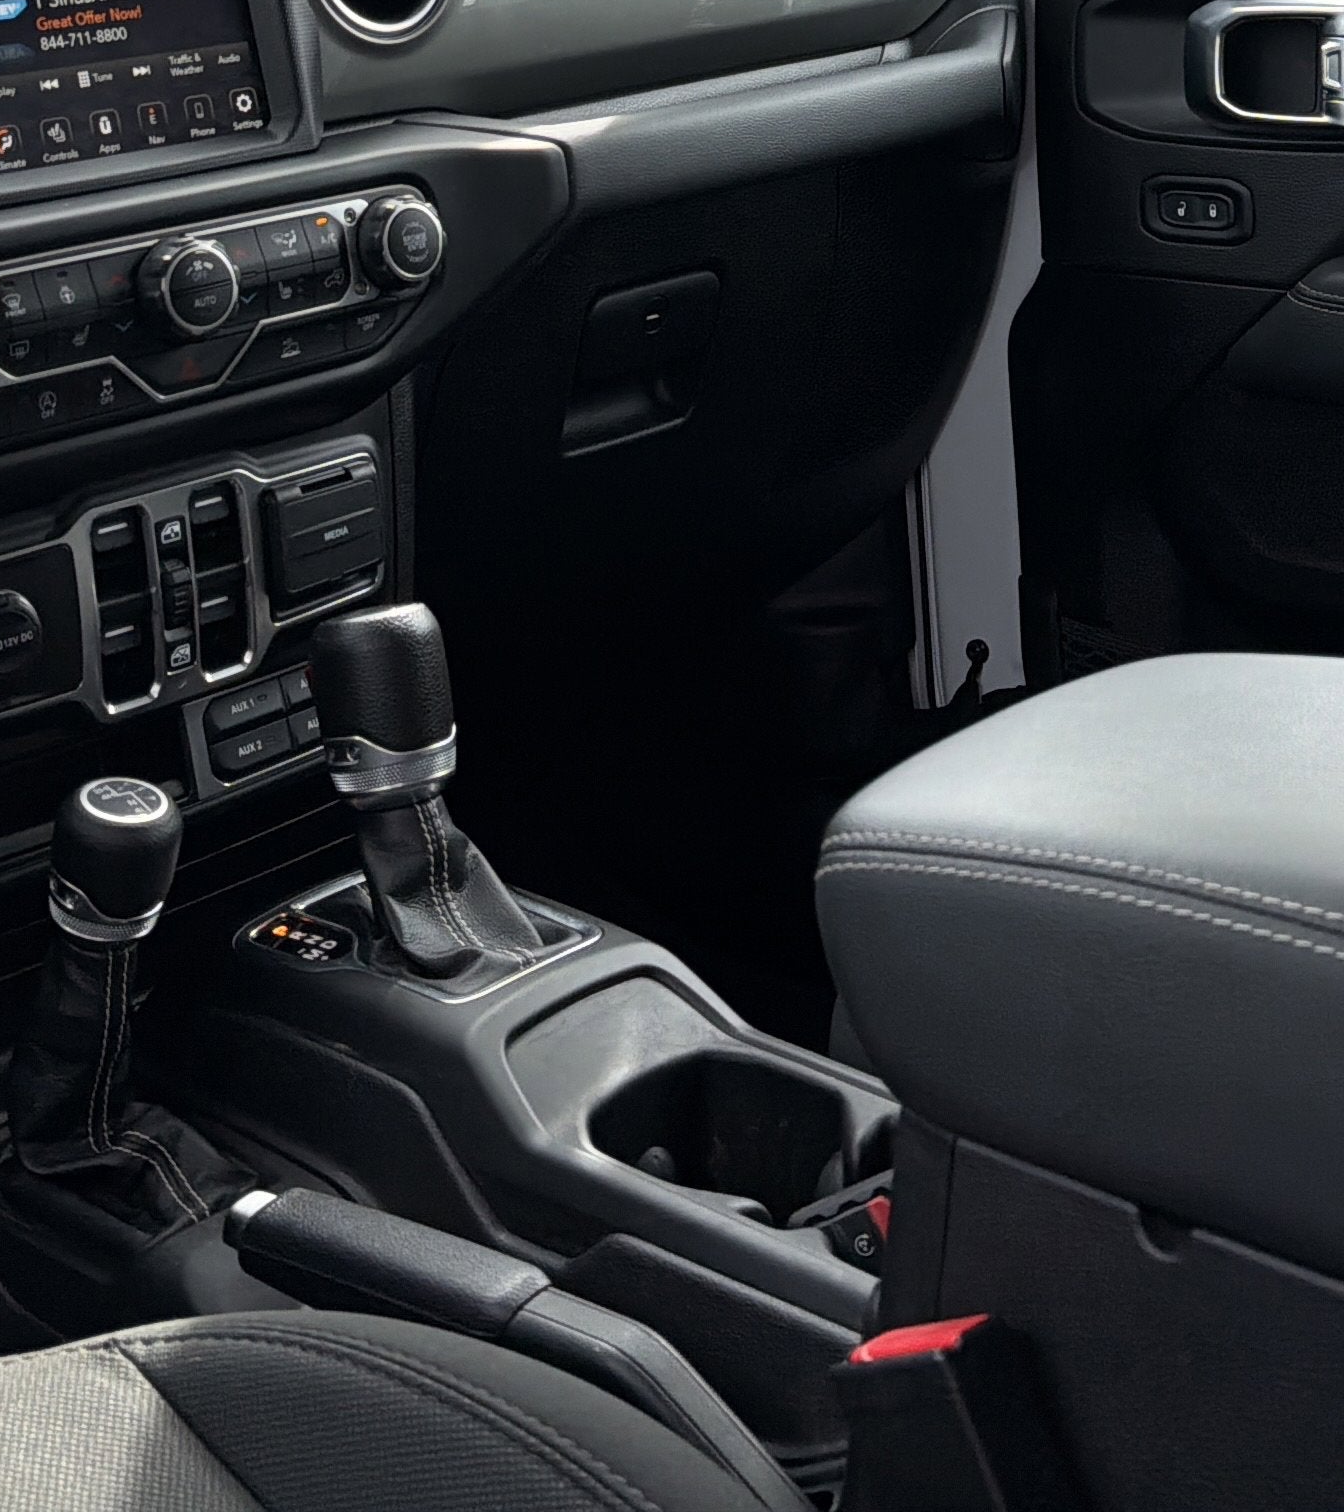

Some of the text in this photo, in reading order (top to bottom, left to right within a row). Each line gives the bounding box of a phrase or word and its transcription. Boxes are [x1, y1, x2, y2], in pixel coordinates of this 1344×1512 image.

[36, 4, 142, 31] Great Offer Now!
[40, 26, 128, 51] 844-711-8800
[168, 54, 193, 66] Traffic
[217, 53, 240, 65] Audio
[170, 65, 204, 77] Weather
[232, 118, 264, 132] Settings
[190, 127, 216, 138] Phone
[148, 136, 166, 145] Nav
[98, 143, 121, 155] Apps
[43, 149, 79, 163] Controls
[194, 295, 217, 308] AUTO
[324, 525, 349, 542] MEDIA
[21, 631, 33, 643] DC
[232, 700, 249, 715] AUX
[308, 717, 320, 730] AU
[239, 742, 256, 758] AUX
